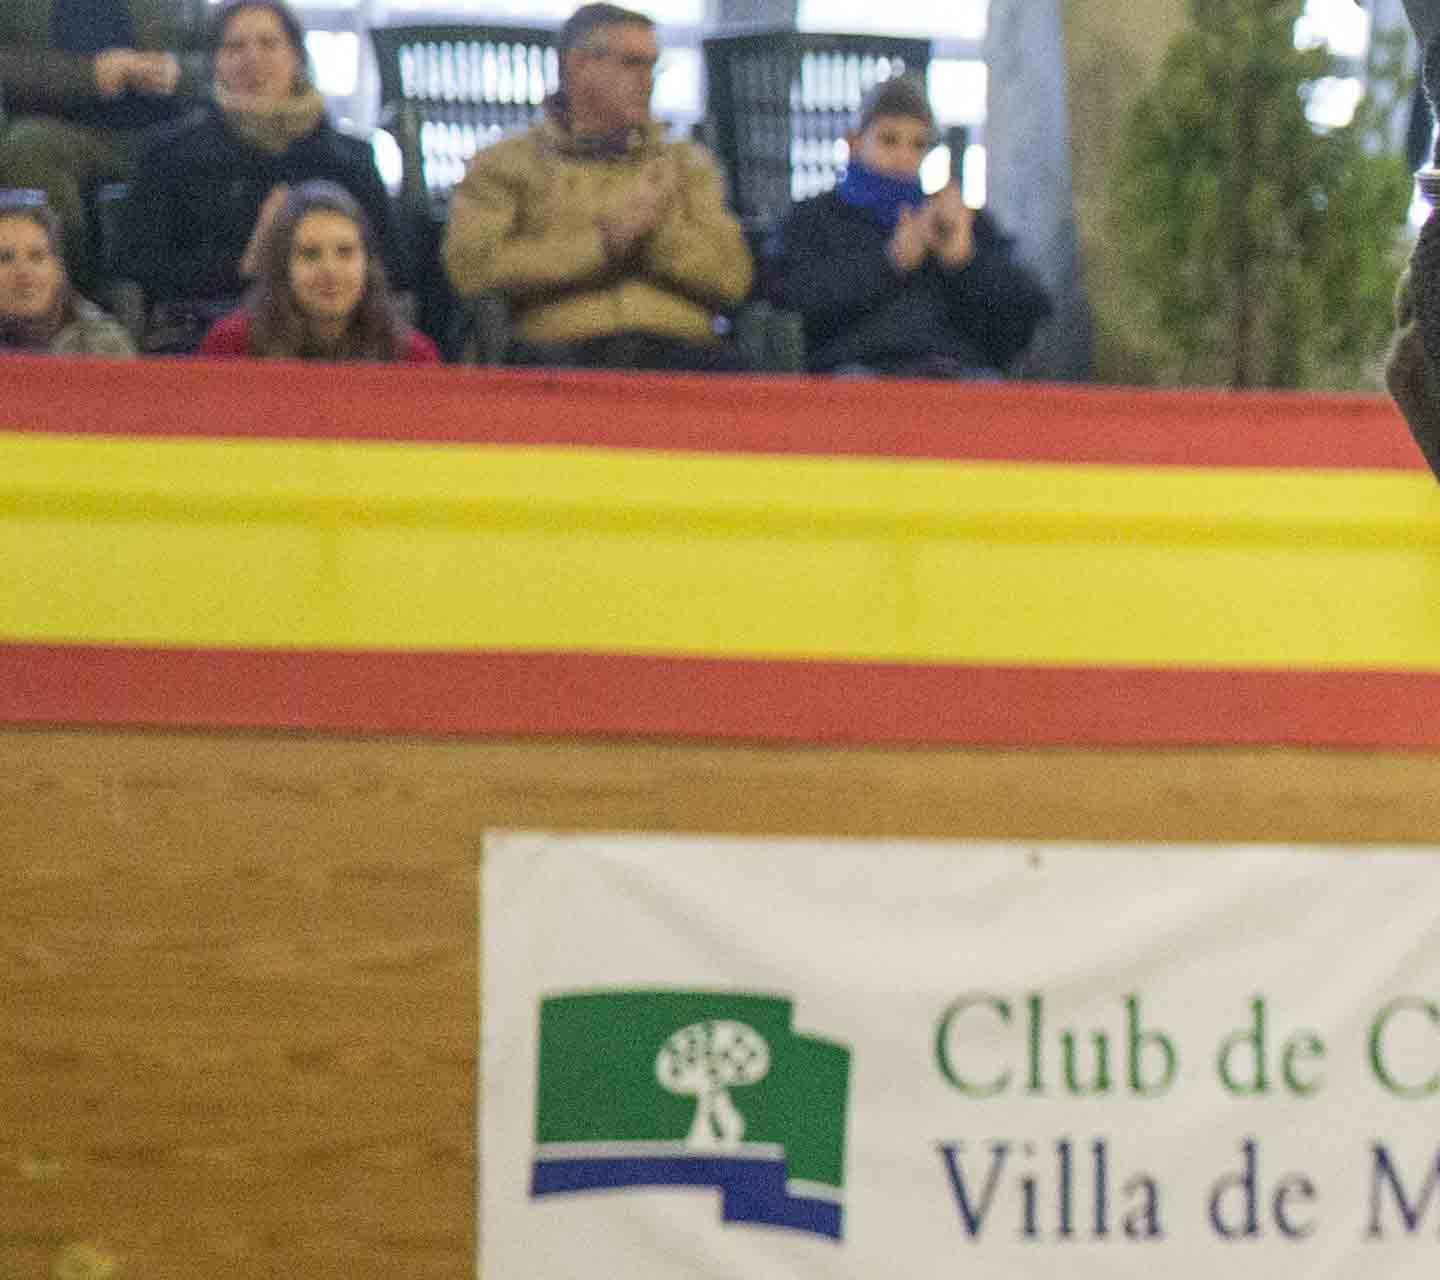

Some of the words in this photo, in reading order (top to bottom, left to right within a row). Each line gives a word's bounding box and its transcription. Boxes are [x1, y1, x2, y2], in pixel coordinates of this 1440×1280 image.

[933, 993, 1178, 1097] Club
[1216, 993, 1326, 1097] de
[934, 1136, 1166, 1241] Villa
[1207, 1136, 1318, 1239] de
